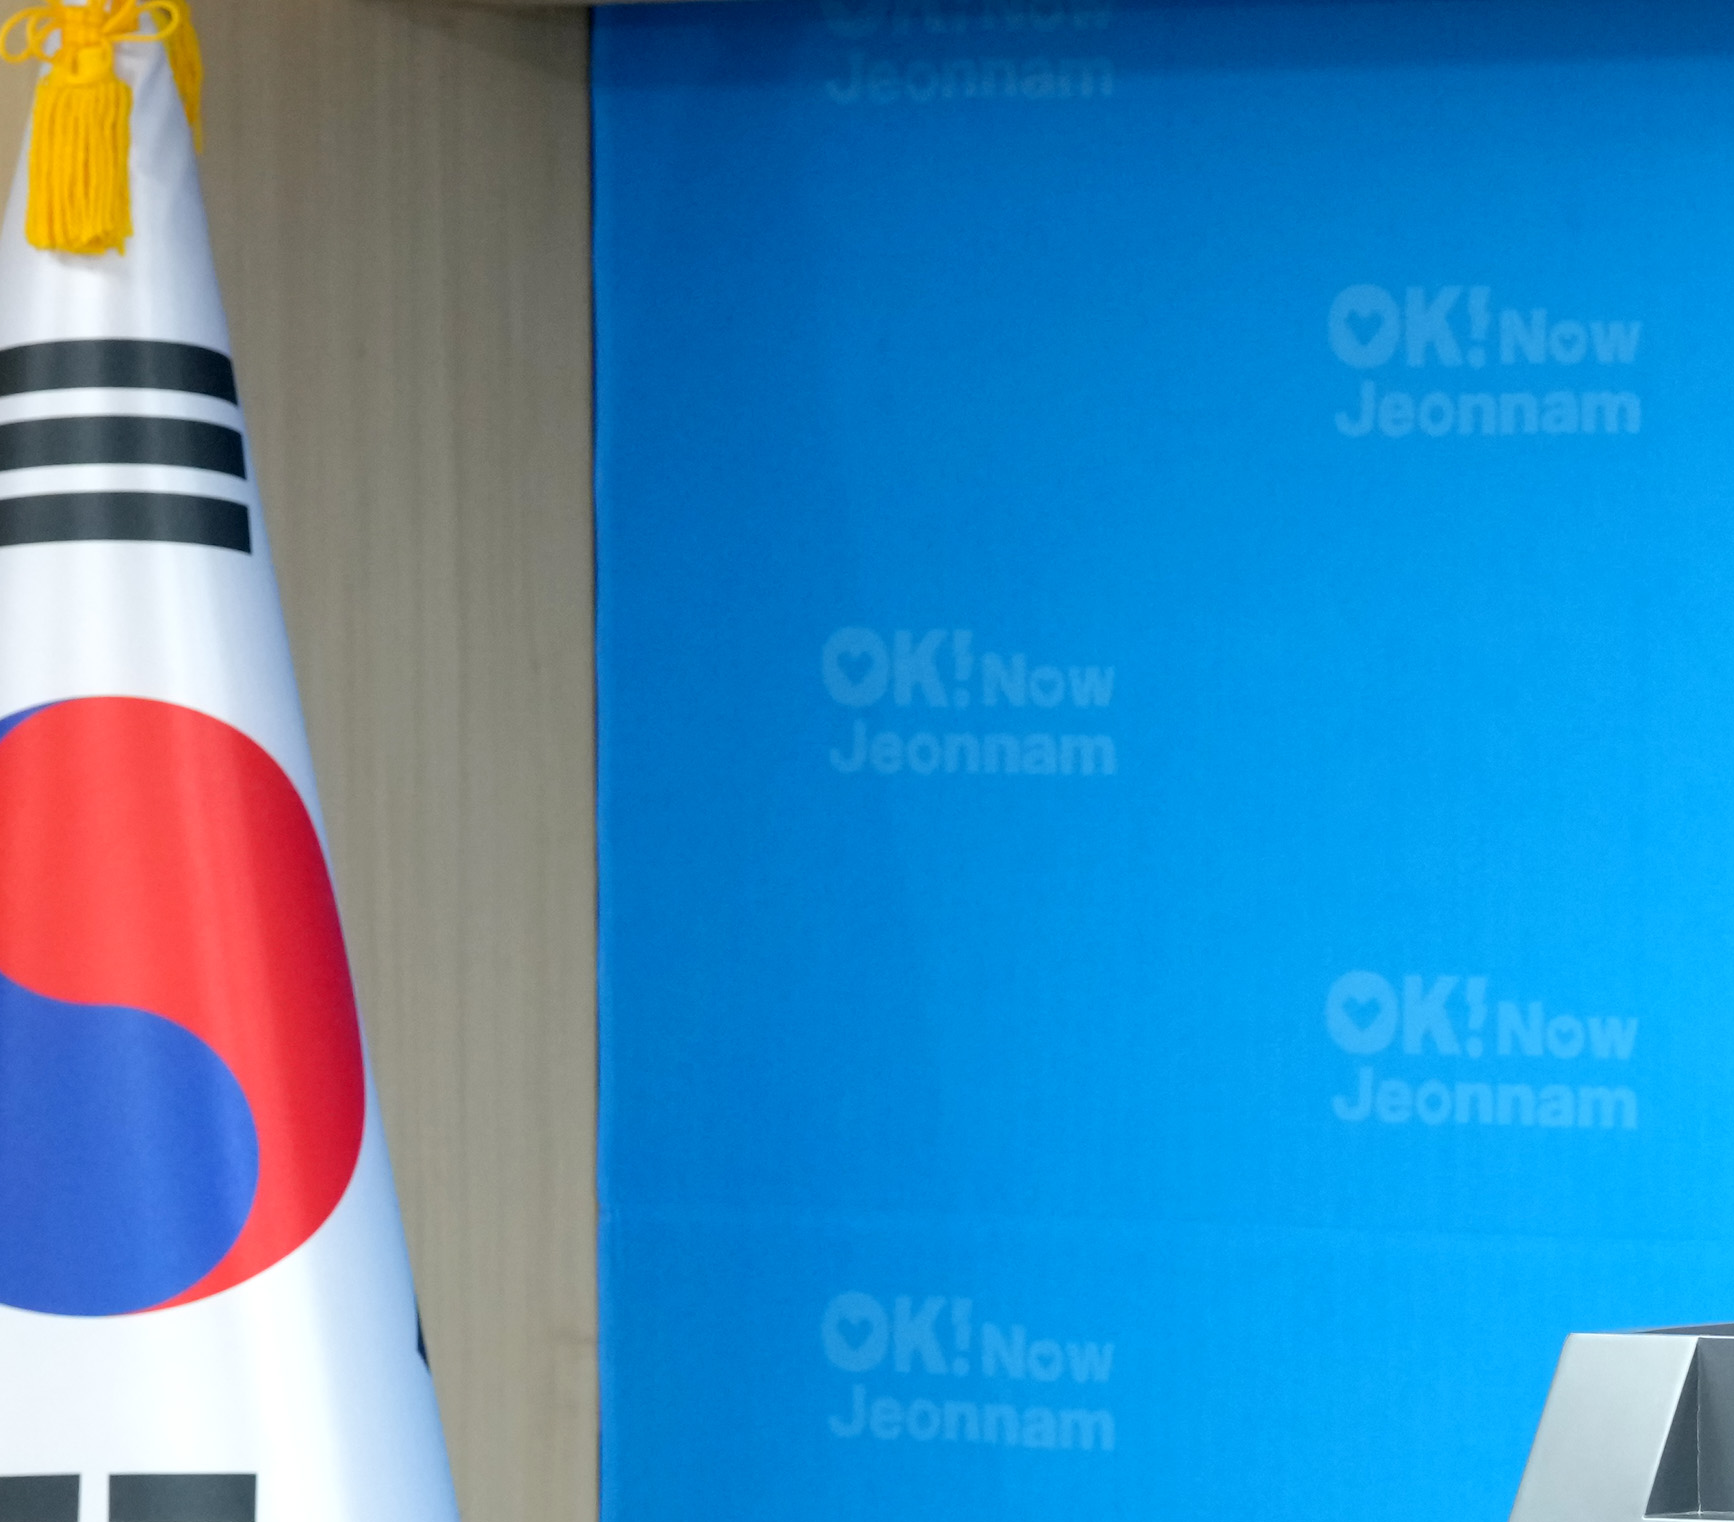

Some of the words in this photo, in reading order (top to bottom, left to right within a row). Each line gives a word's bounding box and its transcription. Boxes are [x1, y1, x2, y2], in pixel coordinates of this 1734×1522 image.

[823, 48, 1116, 104] Jeonnam
[1500, 309, 1643, 366] Now
[1335, 381, 1643, 438] Jeonnam
[982, 653, 1116, 708] Now
[830, 722, 1118, 776] Jeonnam
[1497, 999, 1641, 1061] Now
[1331, 1067, 1639, 1131] Jeonnam
[982, 1325, 1116, 1384] Now
[829, 1386, 1117, 1454] Jeonnam
